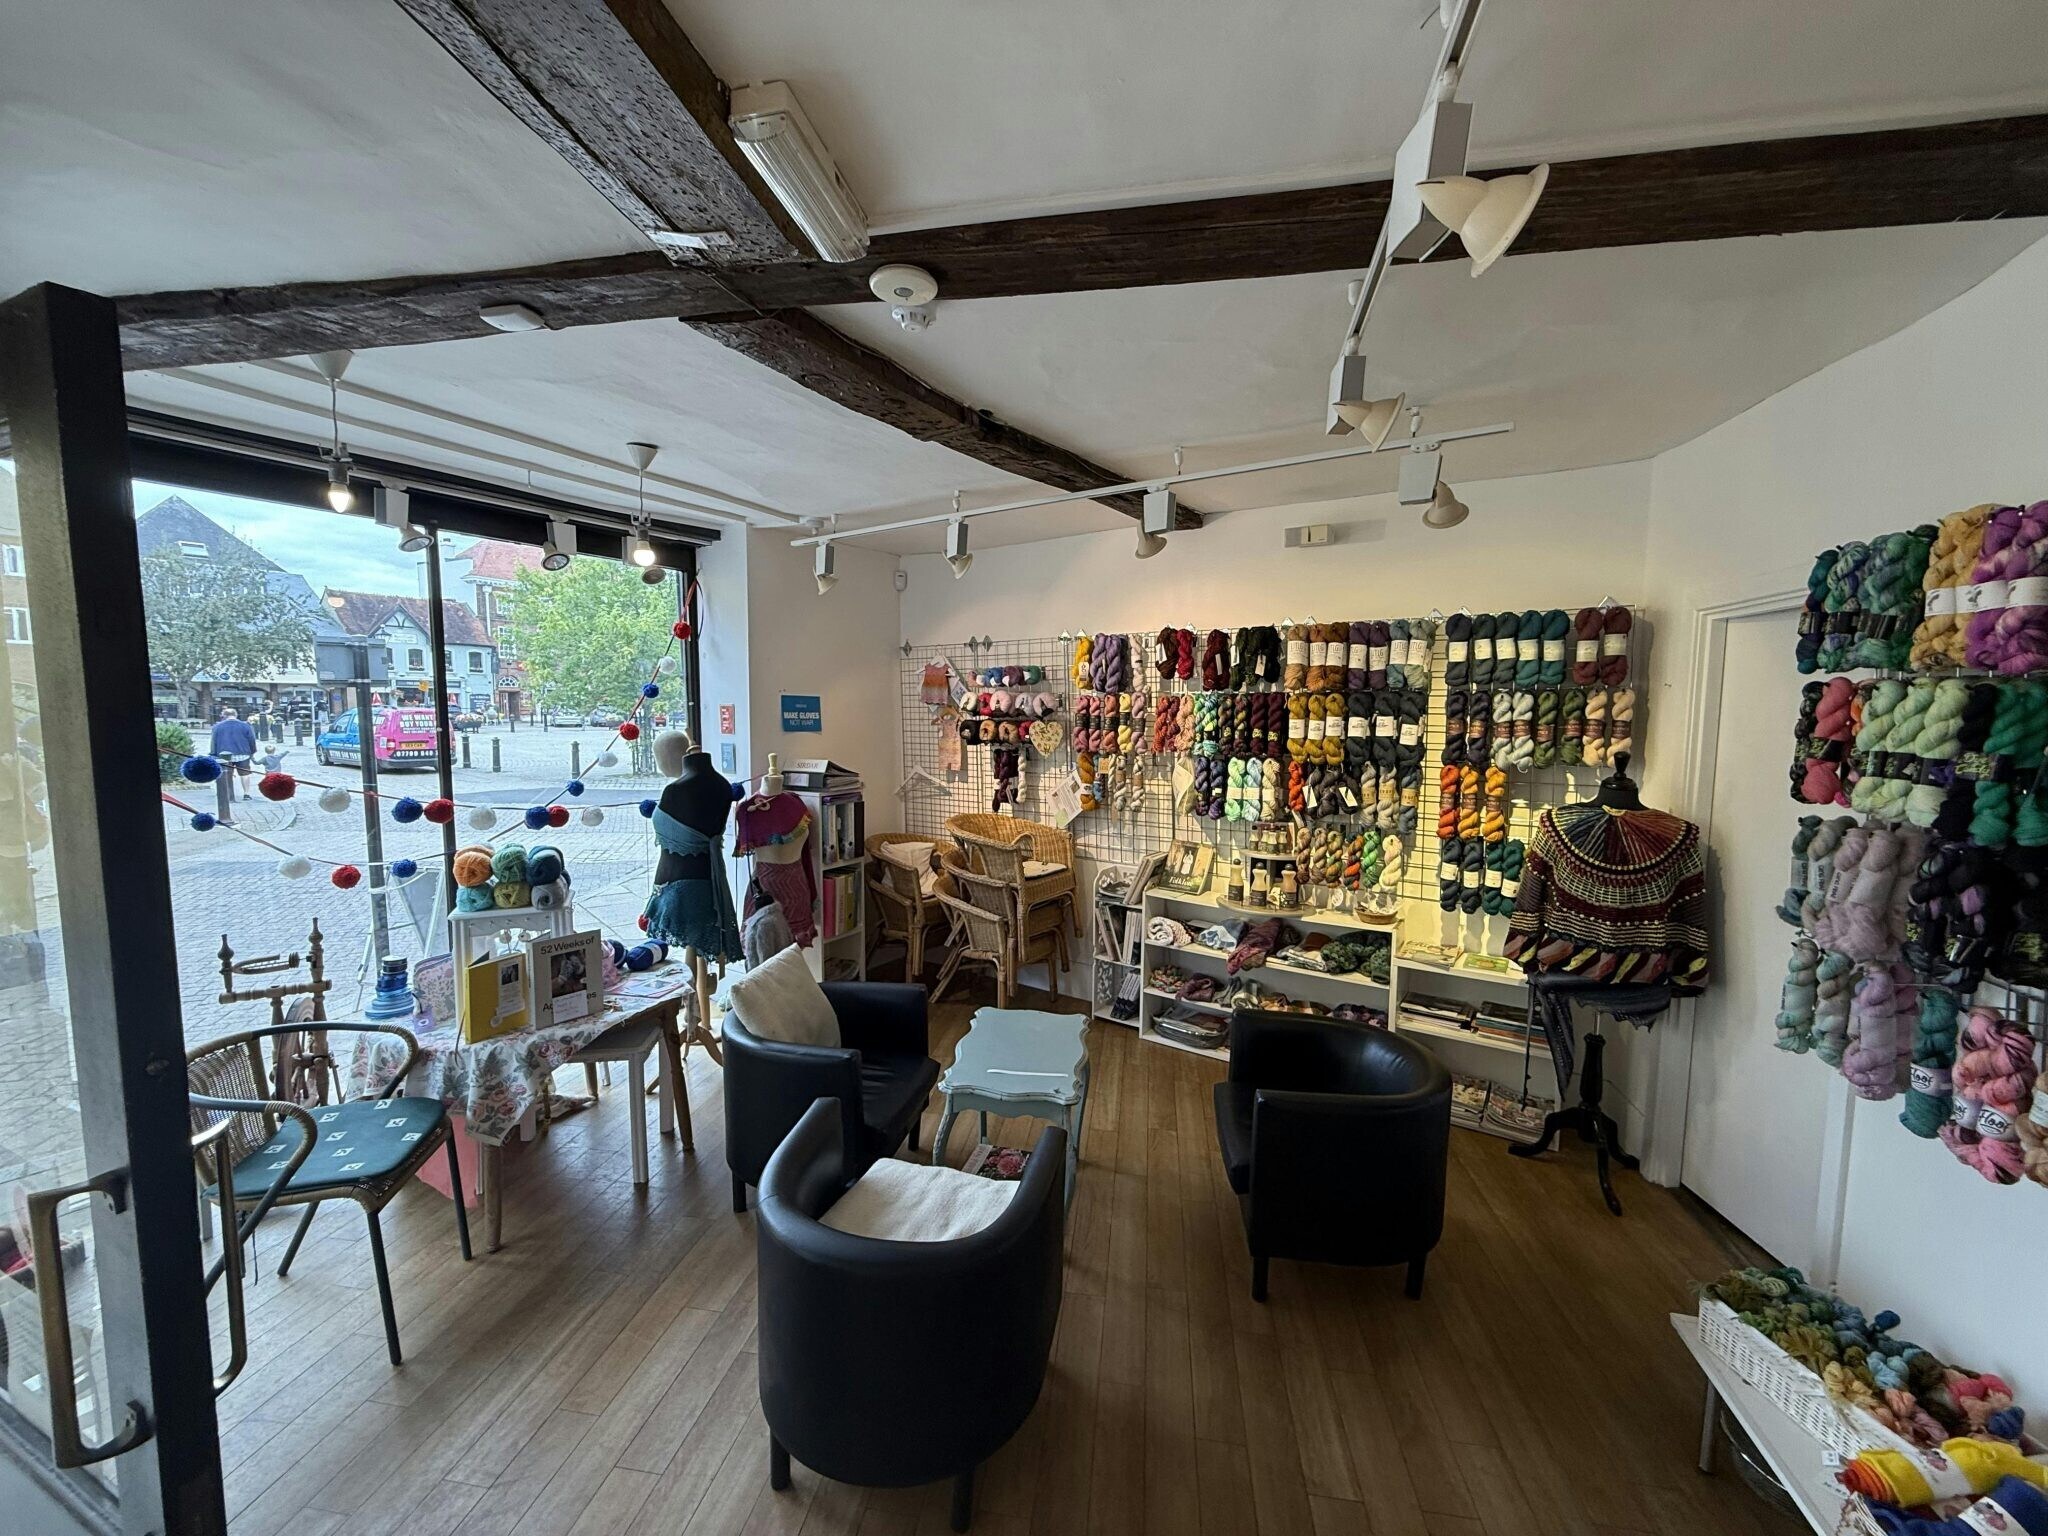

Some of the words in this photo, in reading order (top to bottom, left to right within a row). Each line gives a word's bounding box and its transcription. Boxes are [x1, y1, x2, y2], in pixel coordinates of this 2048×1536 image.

[783, 711, 799, 719] MAKE
[799, 711, 820, 719] GLOVES
[400, 720, 414, 728] BUY
[540, 945, 553, 955] 52
[554, 940, 585, 951] Weeks
[585, 936, 594, 945] of
